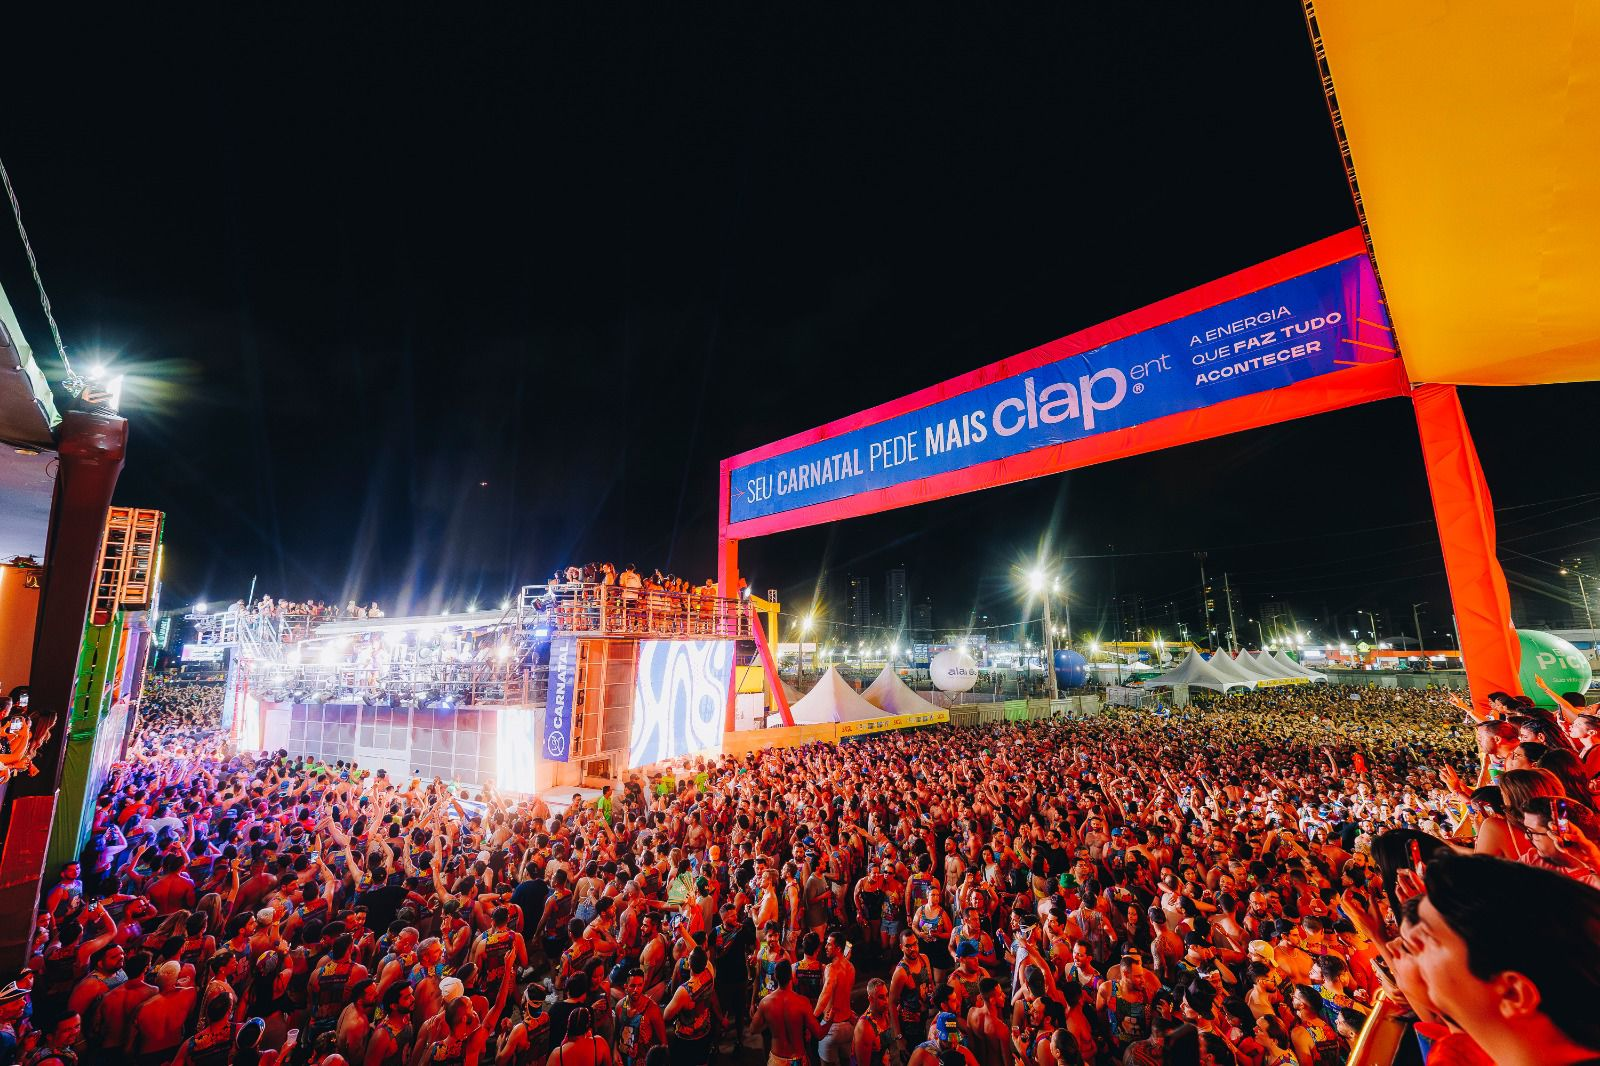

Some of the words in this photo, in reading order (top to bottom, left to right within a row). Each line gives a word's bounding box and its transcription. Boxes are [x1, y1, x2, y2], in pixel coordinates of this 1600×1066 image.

[1189, 335, 1202, 347] A
[1205, 305, 1292, 341] ENERGIA
[1192, 345, 1231, 366] QUE
[1233, 331, 1277, 354] FAZ
[1280, 311, 1342, 338] TUDO
[1195, 340, 1322, 386] ACONTECER
[746, 474, 774, 504] SEU
[777, 448, 864, 496] CARNATAL
[869, 430, 919, 472] PEDE
[925, 410, 988, 458] MAIS
[992, 367, 1127, 437] clap
[1130, 353, 1172, 380] ent
[553, 640, 569, 730] CARNATAL
